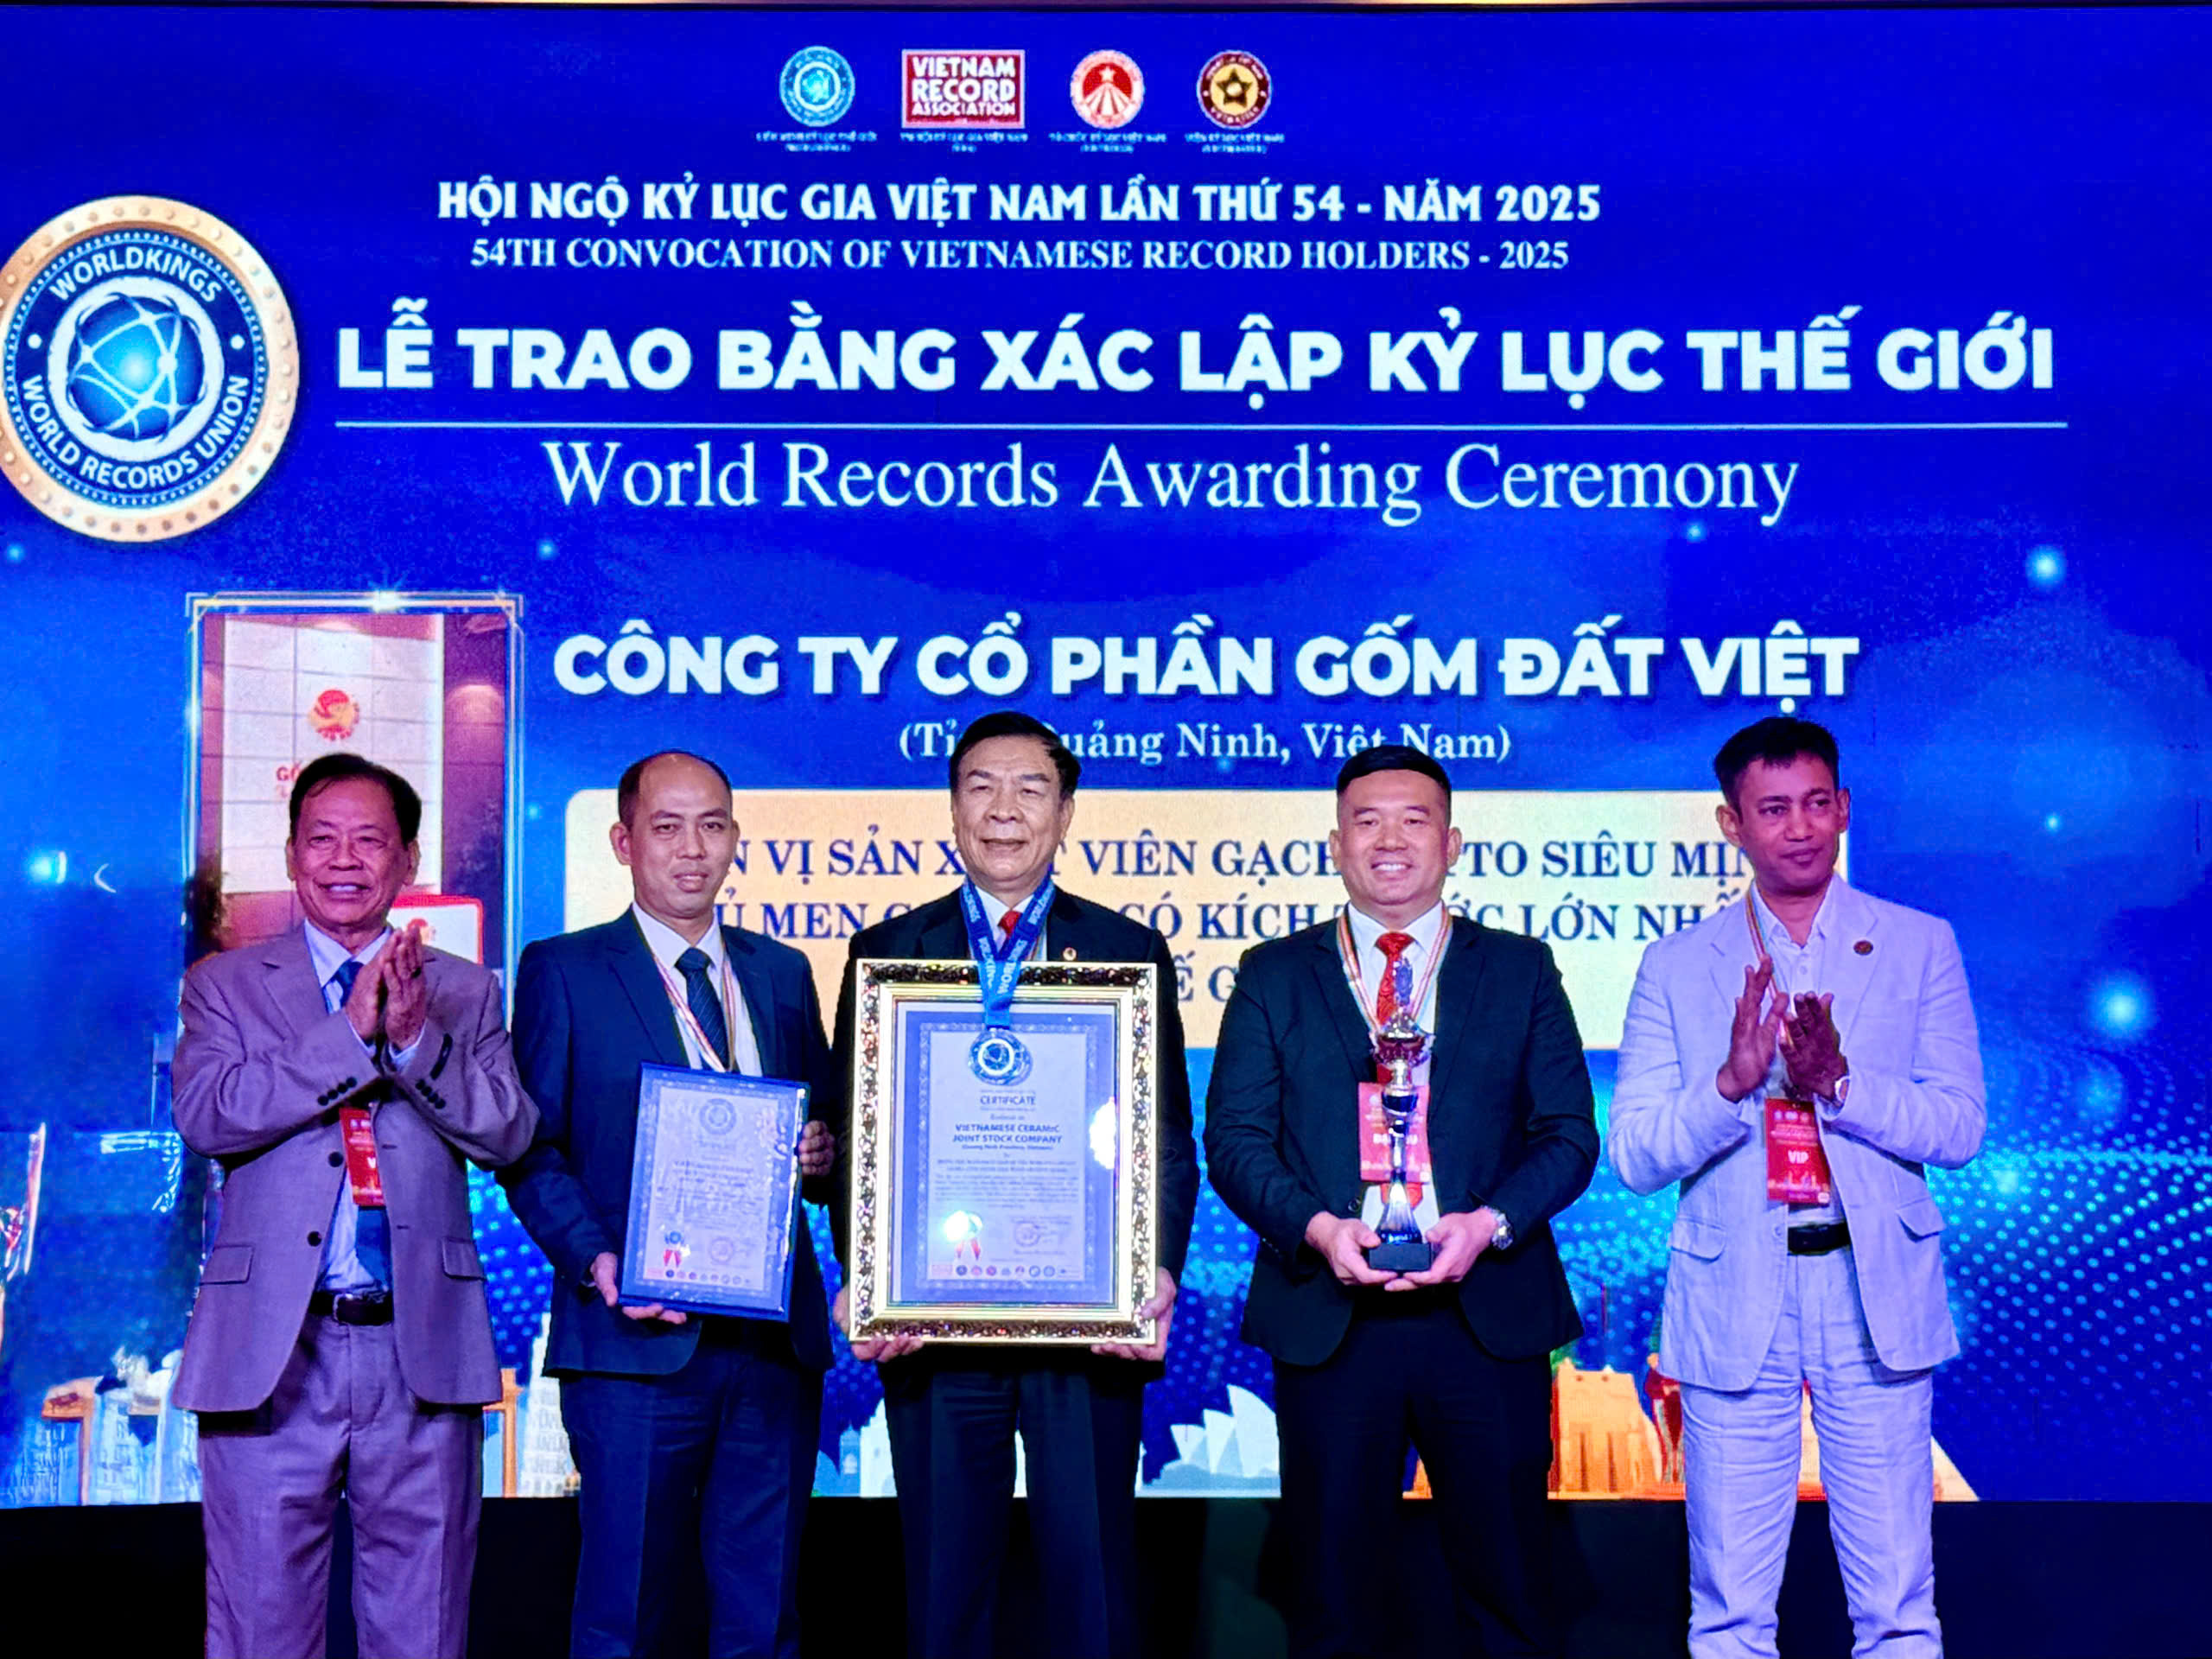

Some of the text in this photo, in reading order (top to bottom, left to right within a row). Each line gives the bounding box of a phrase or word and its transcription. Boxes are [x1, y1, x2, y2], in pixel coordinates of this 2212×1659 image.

[912, 56, 1016, 78] VIETNAM
[912, 79, 1016, 102] RECORD
[912, 102, 1016, 116] ASSOCIATION
[438, 175, 517, 226] HỘI
[531, 176, 629, 226] NGỘ
[643, 171, 699, 219] KỶ
[712, 184, 787, 227] LỤC
[801, 184, 876, 220] GIA
[887, 177, 977, 227] VIỆT
[989, 184, 1086, 221] NAM
[1101, 174, 1179, 222] LẦN
[1192, 177, 1282, 222] THỨ
[1293, 184, 1344, 222] 54
[1384, 178, 1482, 222] NĂM
[1496, 184, 1600, 222] 2025
[49, 246, 222, 302] WORLDKINGS
[471, 238, 556, 268] 54TH
[567, 238, 832, 269] CONVOCATION
[843, 239, 891, 269] OF
[901, 240, 1132, 269] VIETNAMESE
[1144, 240, 1291, 270] RECORD
[1302, 241, 1469, 270] HOLDERS
[1500, 241, 1568, 270] 2025
[339, 297, 2052, 410] LỄ TRAO BẰNG XÁC LẬP KỶ LỤC THẾ GIỚI
[22, 375, 249, 490] WORLD RECORDS UNION
[541, 442, 1799, 531] World Records Awarding Ceremony
[554, 612, 1859, 715] CÔNG TY CỔ PHẦN GỐM ĐẤT VIỆT
[899, 719, 959, 760] (Tỉ
[1046, 719, 1164, 765] uảng
[1178, 723, 1289, 765] Ninh,
[1401, 723, 1511, 763] Nam)
[762, 840, 814, 884] VỊ
[828, 823, 923, 876] SẢN
[1079, 829, 1198, 876] VIÊN
[1541, 830, 1657, 877] SIÊU
[761, 903, 867, 938] MEN
[1198, 893, 1317, 940] KÍCH
[1519, 892, 1618, 941] LỚN
[980, 1096, 1036, 1106] CERTIFICATE
[953, 1134, 1063, 1144] JOINT STOCK COMPANY
[955, 1123, 1060, 1133] VIETNAMESE CERAMIC
[1788, 1149, 1809, 1164] VIP
